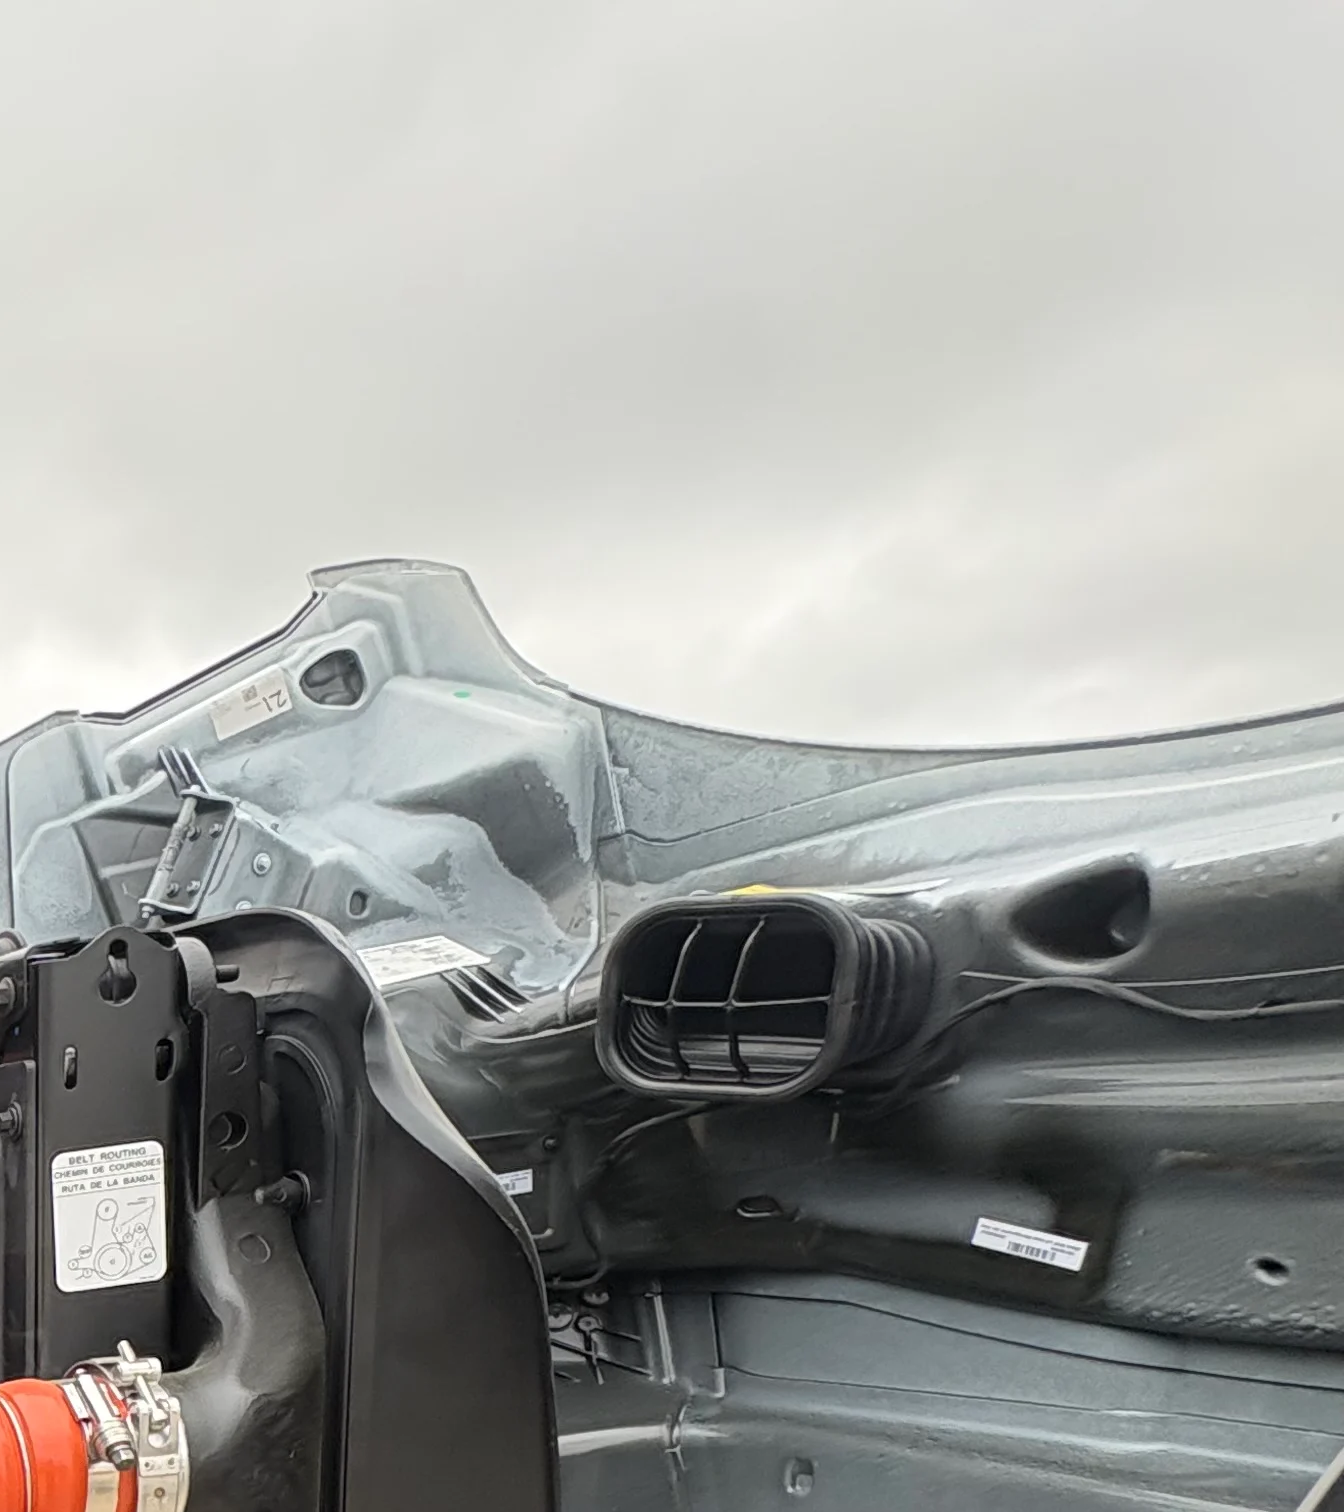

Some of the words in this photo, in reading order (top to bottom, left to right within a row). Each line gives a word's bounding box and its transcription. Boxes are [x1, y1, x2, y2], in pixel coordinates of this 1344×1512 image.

[68, 1154, 95, 1165] BELT
[100, 1147, 147, 1160] ROUTING
[92, 1165, 104, 1174] DE
[61, 1184, 86, 1193] RUTA
[90, 1181, 102, 1189] DE
[106, 1179, 118, 1187] LA
[123, 1174, 155, 1185] BANDA
